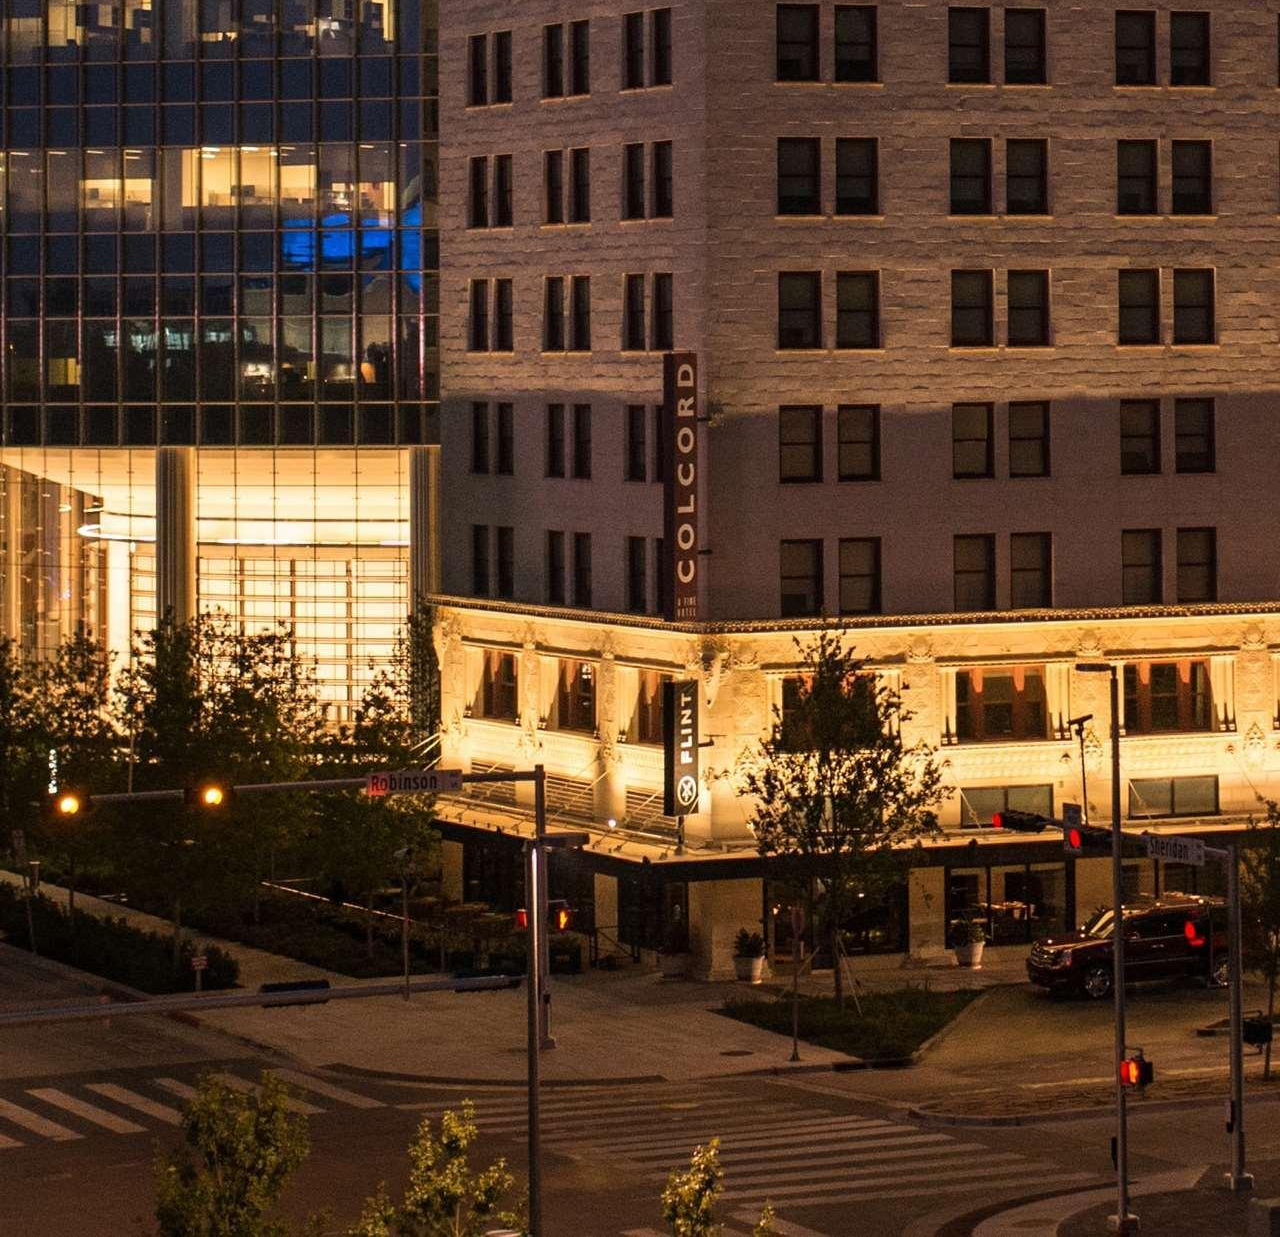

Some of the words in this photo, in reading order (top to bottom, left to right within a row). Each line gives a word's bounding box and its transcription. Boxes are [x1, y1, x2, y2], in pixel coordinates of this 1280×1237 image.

[677, 363, 695, 584] COLCORD
[680, 692, 693, 765] FLINT
[371, 774, 438, 791] Robinson
